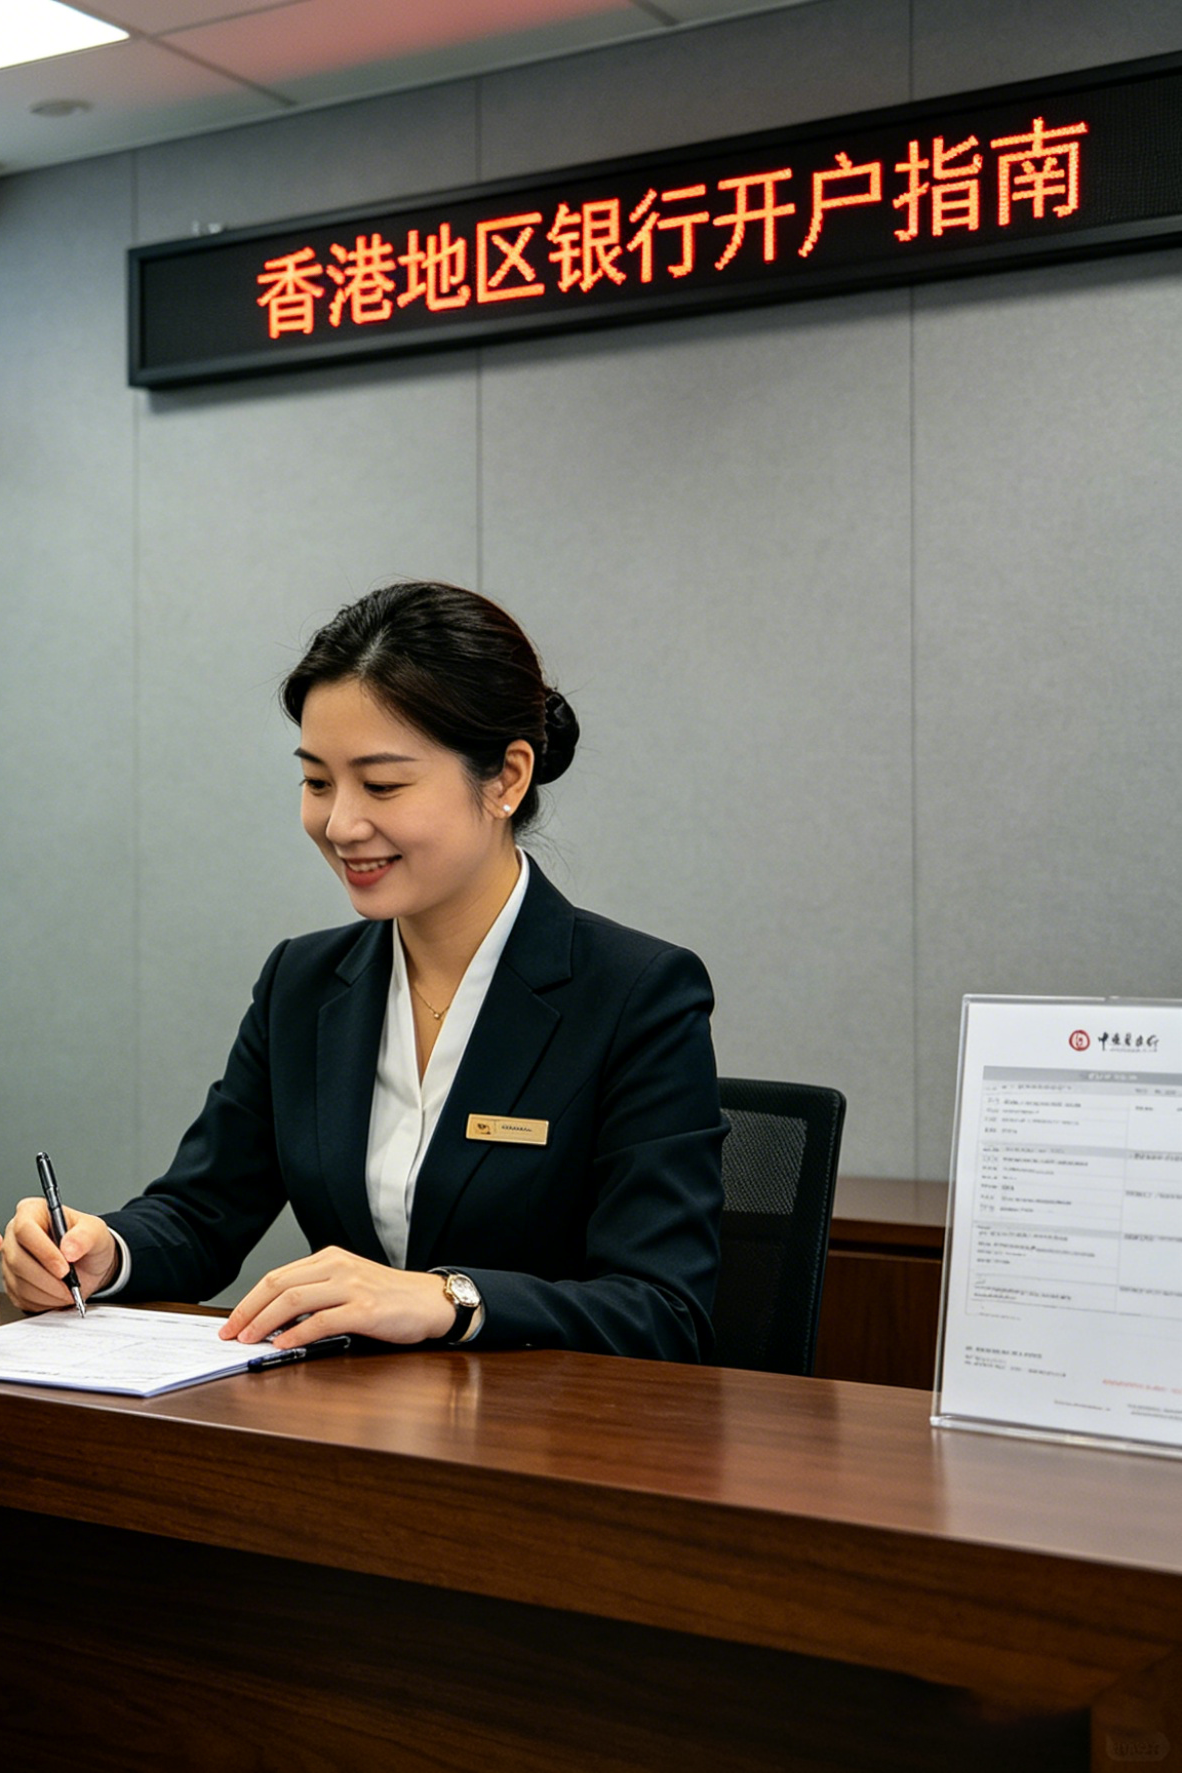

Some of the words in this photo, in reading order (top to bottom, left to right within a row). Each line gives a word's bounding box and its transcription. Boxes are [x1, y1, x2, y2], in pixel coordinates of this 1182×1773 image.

[256, 116, 1089, 340] 香港地区银行开户指南
